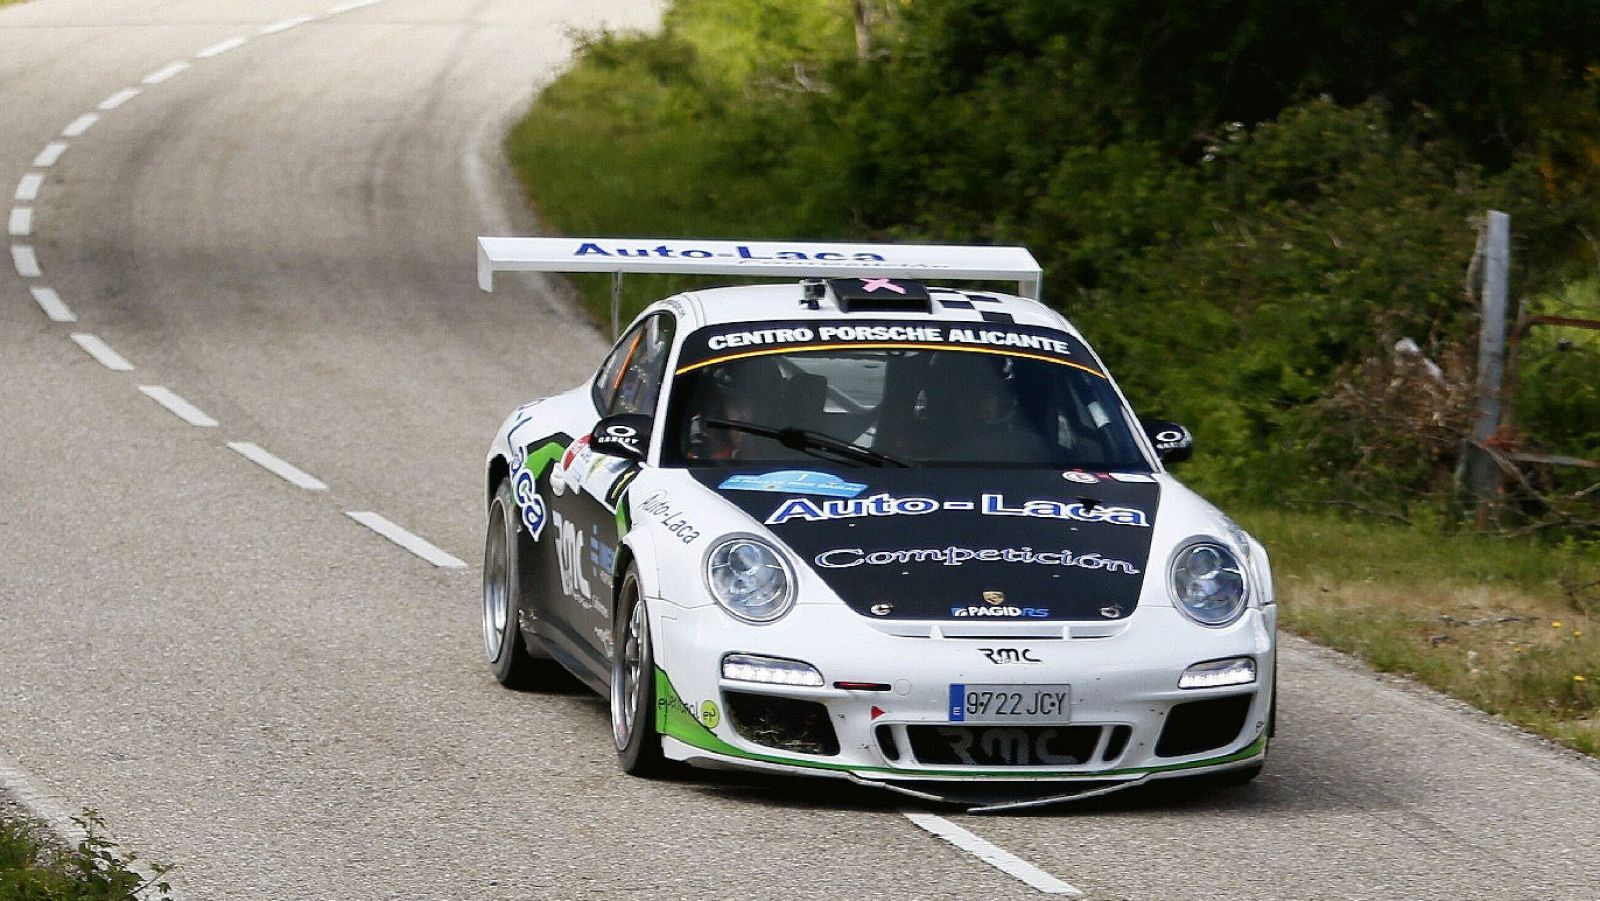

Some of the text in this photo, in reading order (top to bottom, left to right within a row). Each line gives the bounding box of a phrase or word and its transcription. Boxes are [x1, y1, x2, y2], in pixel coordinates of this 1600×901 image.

[573, 241, 886, 262] Auto-Laca
[708, 325, 1072, 356] CENTRO PORSCHE ALICANTE
[763, 493, 1150, 527] Auto-Laca
[814, 545, 1141, 575] Competición
[976, 648, 1042, 665] RMC
[966, 691, 1066, 715] 9722 JCY
